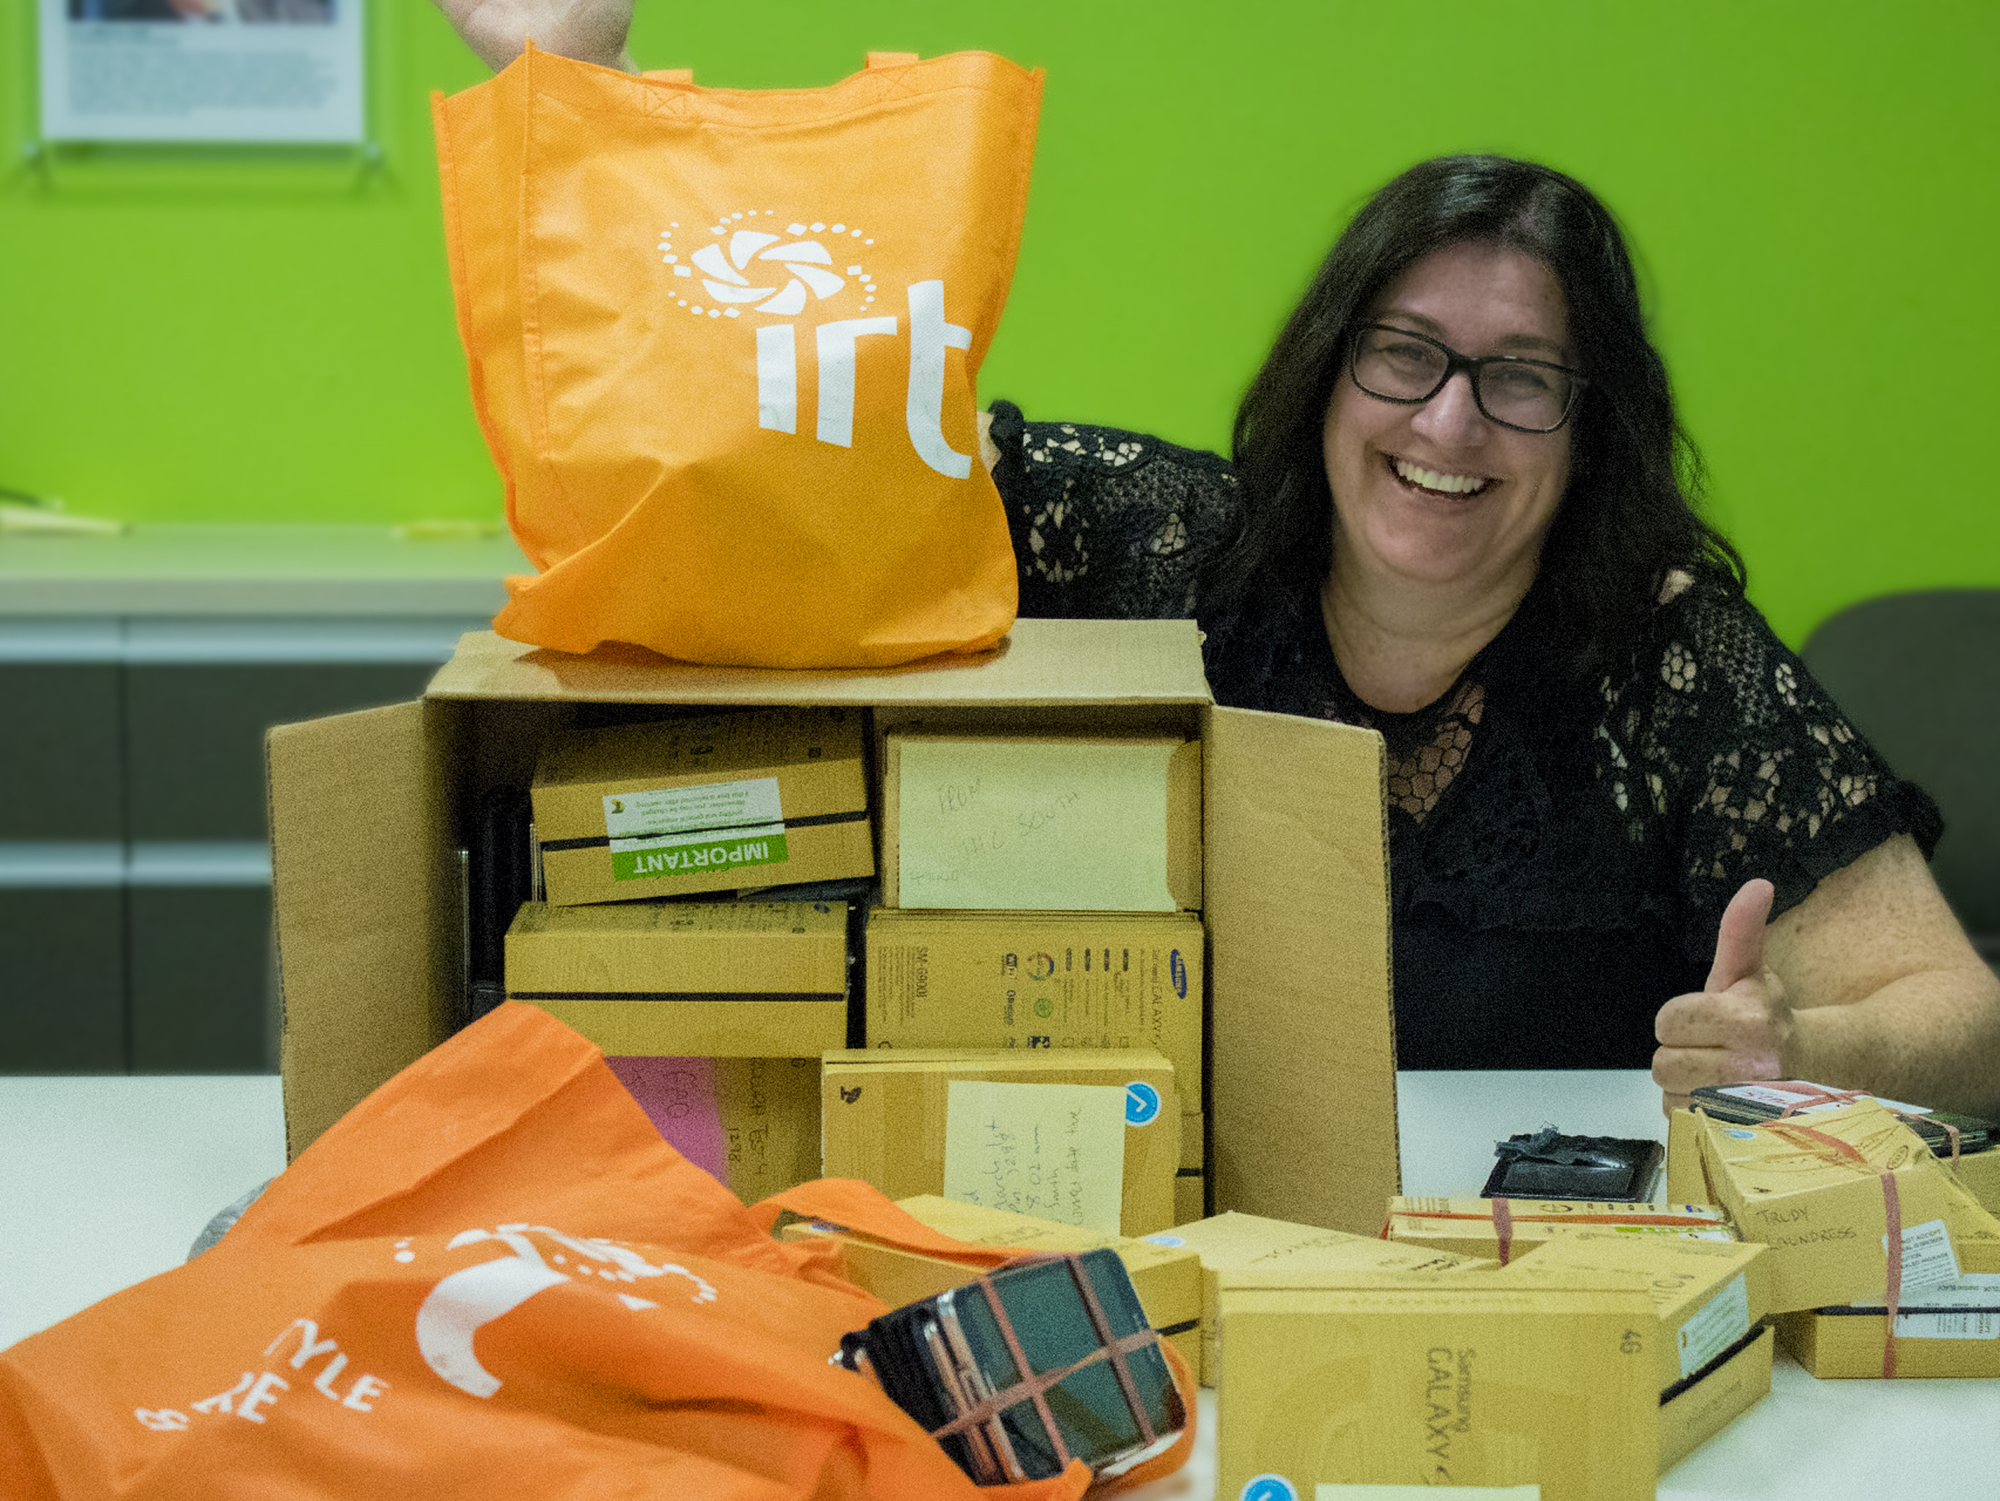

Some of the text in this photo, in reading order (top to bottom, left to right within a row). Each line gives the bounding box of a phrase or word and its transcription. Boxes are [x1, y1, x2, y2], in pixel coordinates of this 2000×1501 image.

[756, 280, 972, 479] irt
[633, 842, 769, 874] IMPORTANT
[1620, 1328, 1643, 1355] 4G
[1425, 1346, 1454, 1460] GALAXY
[1453, 1347, 1478, 1434] Samsung
